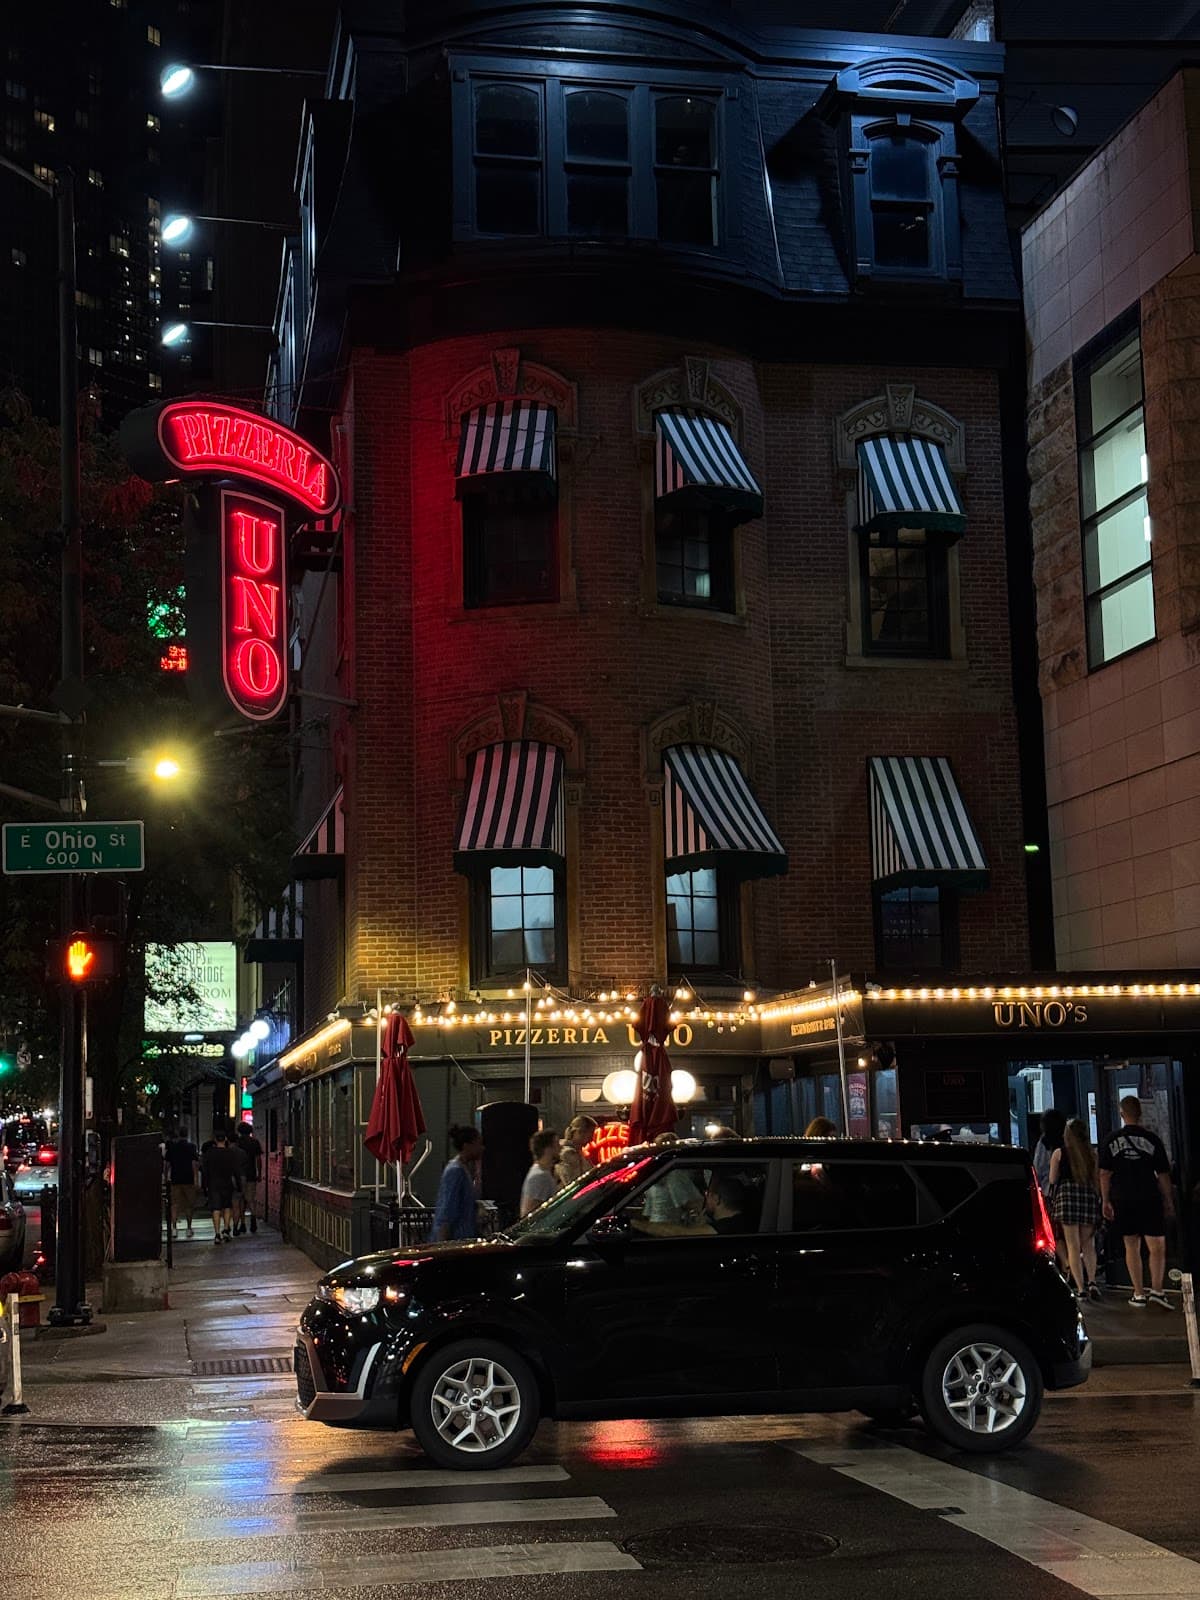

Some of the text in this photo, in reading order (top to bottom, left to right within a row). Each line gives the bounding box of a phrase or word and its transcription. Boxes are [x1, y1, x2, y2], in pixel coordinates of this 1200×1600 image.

[171, 411, 327, 506] PIZZERIA
[233, 511, 281, 696] UNO
[21, 831, 126, 849] E Ohio St
[46, 851, 103, 865] 600 N
[490, 1027, 610, 1046] PIZZERIA
[626, 1022, 693, 1047] UO
